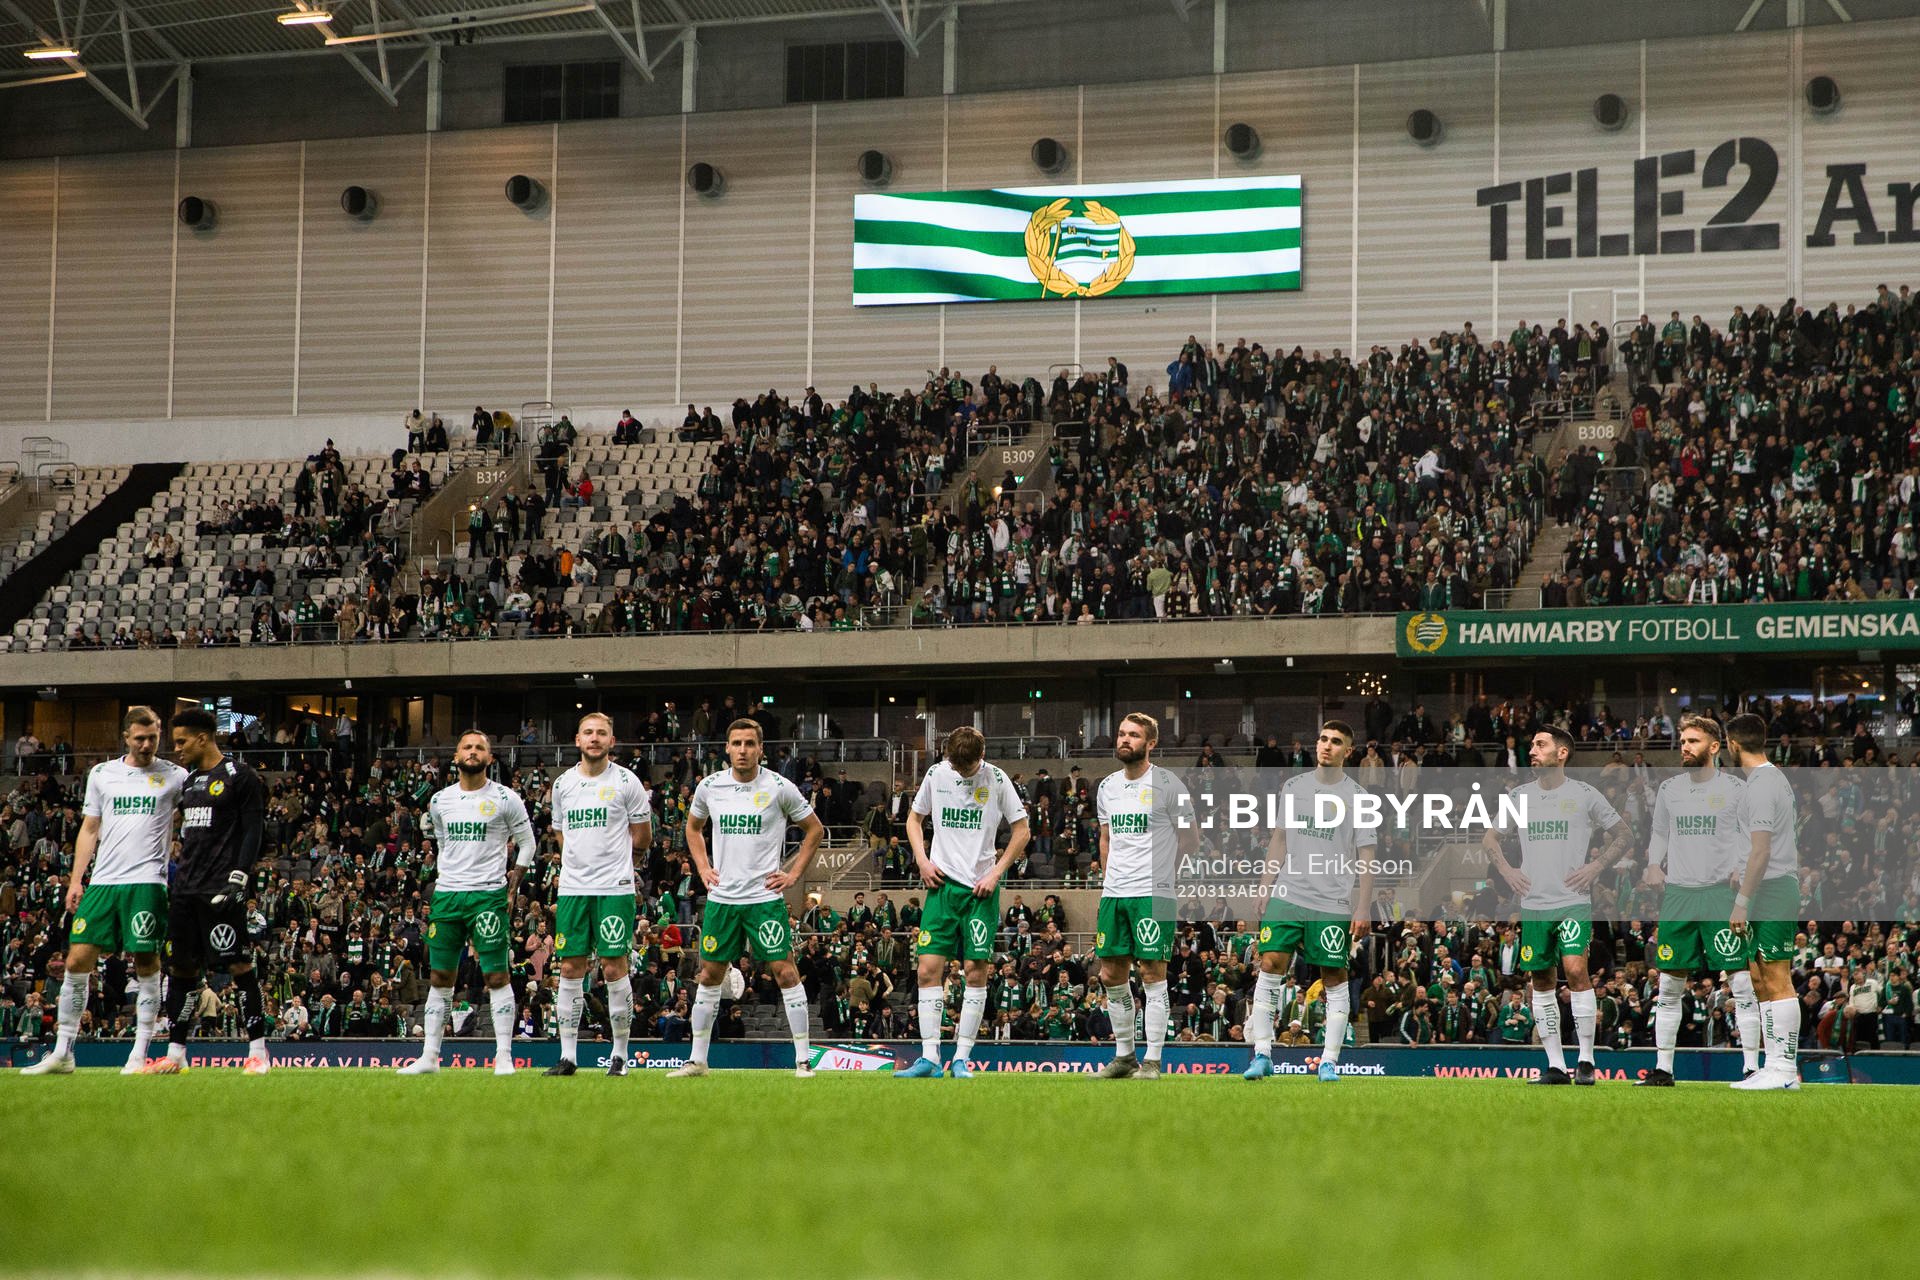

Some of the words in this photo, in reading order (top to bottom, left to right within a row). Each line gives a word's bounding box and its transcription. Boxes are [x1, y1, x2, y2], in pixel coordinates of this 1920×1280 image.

[1476, 136, 1780, 261] TELE2
[1578, 425, 1614, 440] B308
[1003, 450, 1035, 464] B309
[1459, 620, 1622, 644] HAMMARBY
[1628, 618, 1740, 641] FOTBOLL
[1756, 613, 1920, 639] GEMENSKA
[113, 795, 156, 810] HUSKI
[112, 807, 156, 816] CHOCOLATE
[567, 808, 608, 824] HUSKI
[942, 807, 982, 823] HUSKI
[447, 821, 487, 835] HUSKI
[567, 822, 607, 831] CHOCOLATE
[719, 814, 763, 828] HUSKI
[941, 821, 982, 830] CHOCOLATE
[1109, 813, 1149, 828] HUSKI
[1527, 820, 1569, 834] HUSKI
[1677, 815, 1717, 829] HUSKI
[719, 827, 763, 835] CHOCOLATE
[1528, 832, 1569, 842] CHOCOLATE
[1677, 827, 1716, 836] CHOCOLATE
[131, 911, 156, 937] VW
[476, 911, 500, 937] VW
[600, 915, 625, 943] VW
[210, 924, 236, 951] VW
[759, 920, 784, 948] VW
[969, 918, 987, 946] VW
[1137, 918, 1160, 946] VW
[1320, 925, 1345, 953] VW
[1273, 1063, 1307, 1074] efina
[1335, 1063, 1385, 1075] ntbank
